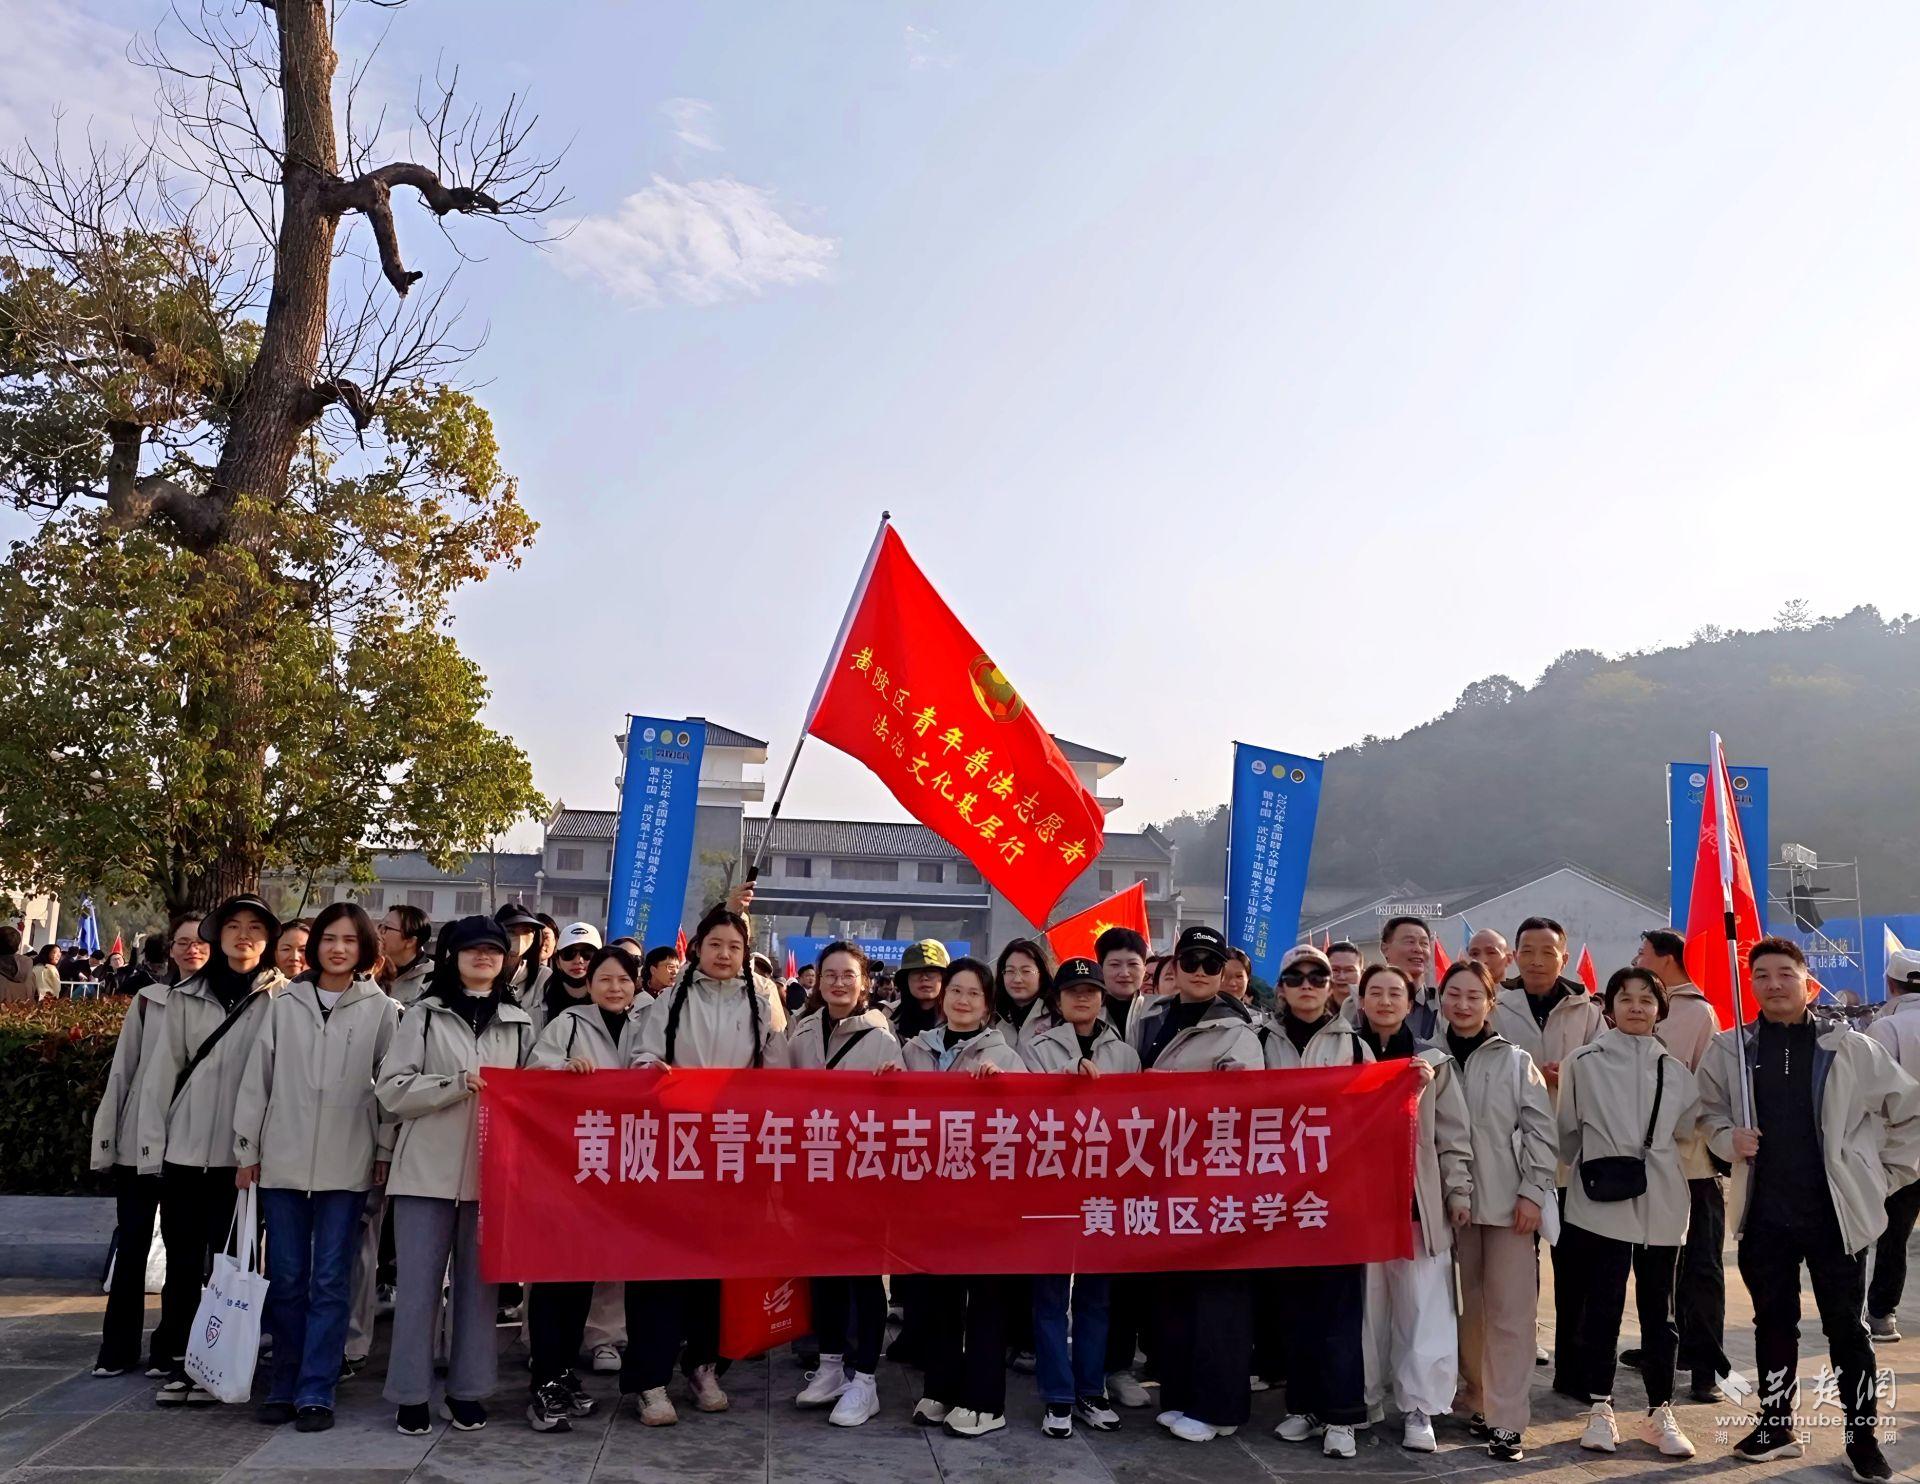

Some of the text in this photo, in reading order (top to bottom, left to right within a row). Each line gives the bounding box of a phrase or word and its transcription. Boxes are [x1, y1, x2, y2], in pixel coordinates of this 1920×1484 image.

[850, 646, 1086, 865] 黄陂区青年普法志愿者
[872, 713, 1027, 866] 法治文化基层行
[573, 1104, 1331, 1185] 黄陂区青年普法志愿者法治文化基层行
